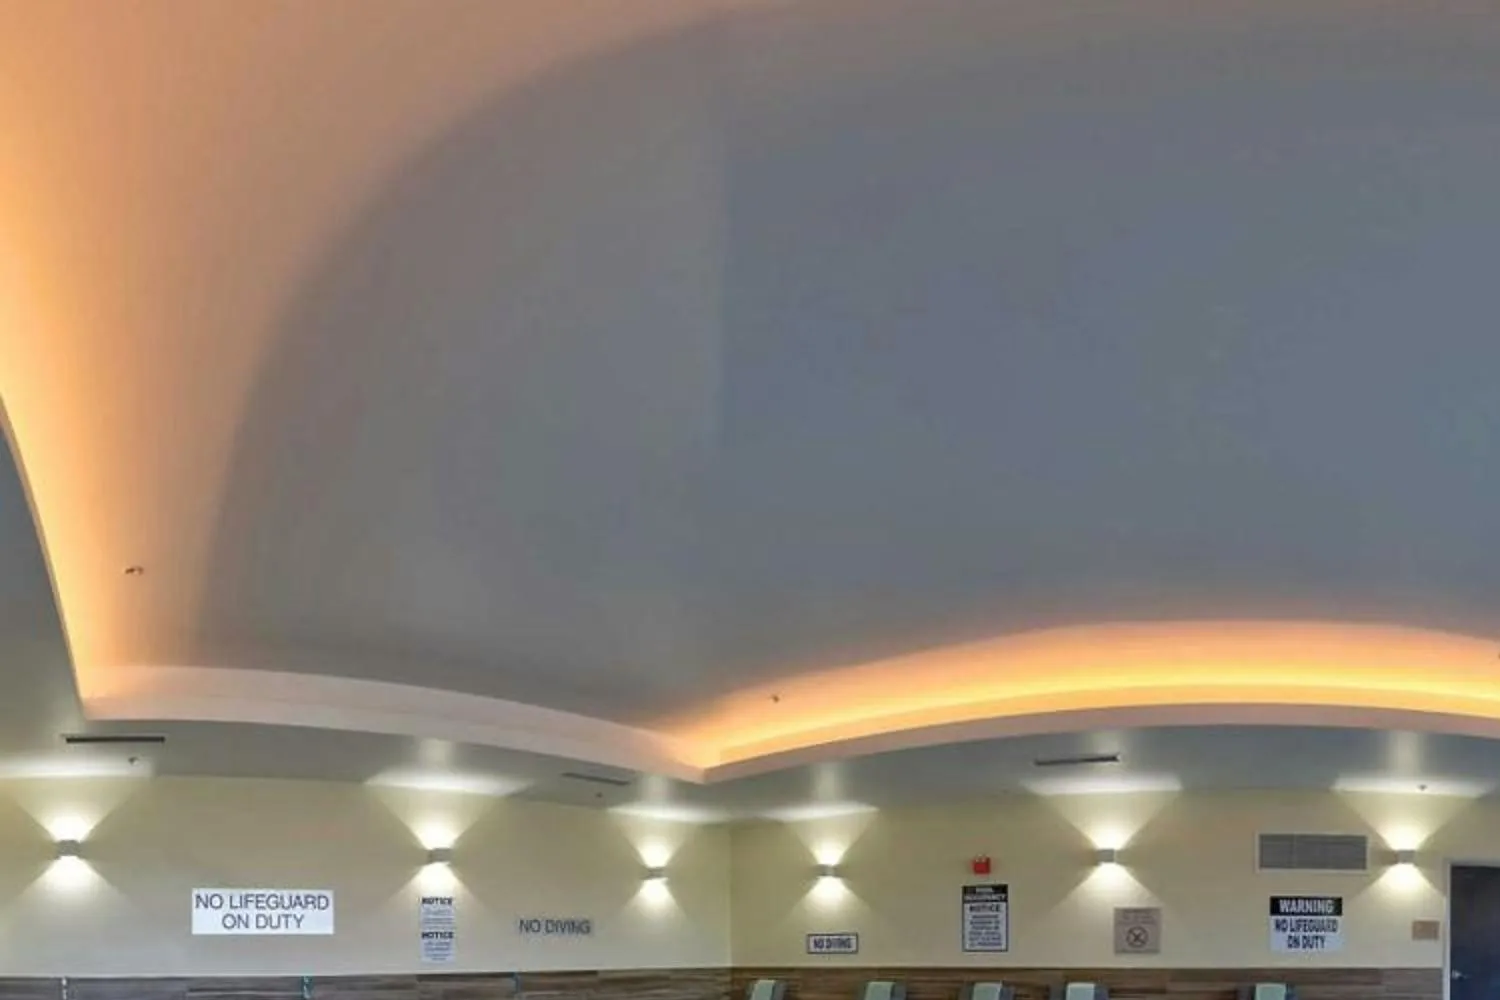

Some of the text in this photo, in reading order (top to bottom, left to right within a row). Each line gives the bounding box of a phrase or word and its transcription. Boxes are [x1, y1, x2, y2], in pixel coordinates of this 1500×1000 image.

[195, 893, 329, 910] NO LIFEGUARD
[1279, 899, 1335, 914] WARNING
[222, 913, 305, 929] ON DUTY
[519, 919, 591, 934] NO DIVING
[1275, 918, 1337, 932] NO LIFEGUARD
[422, 931, 454, 940] NOTICE
[1287, 935, 1326, 949] ON DUTY
[813, 938, 825, 949] NO
